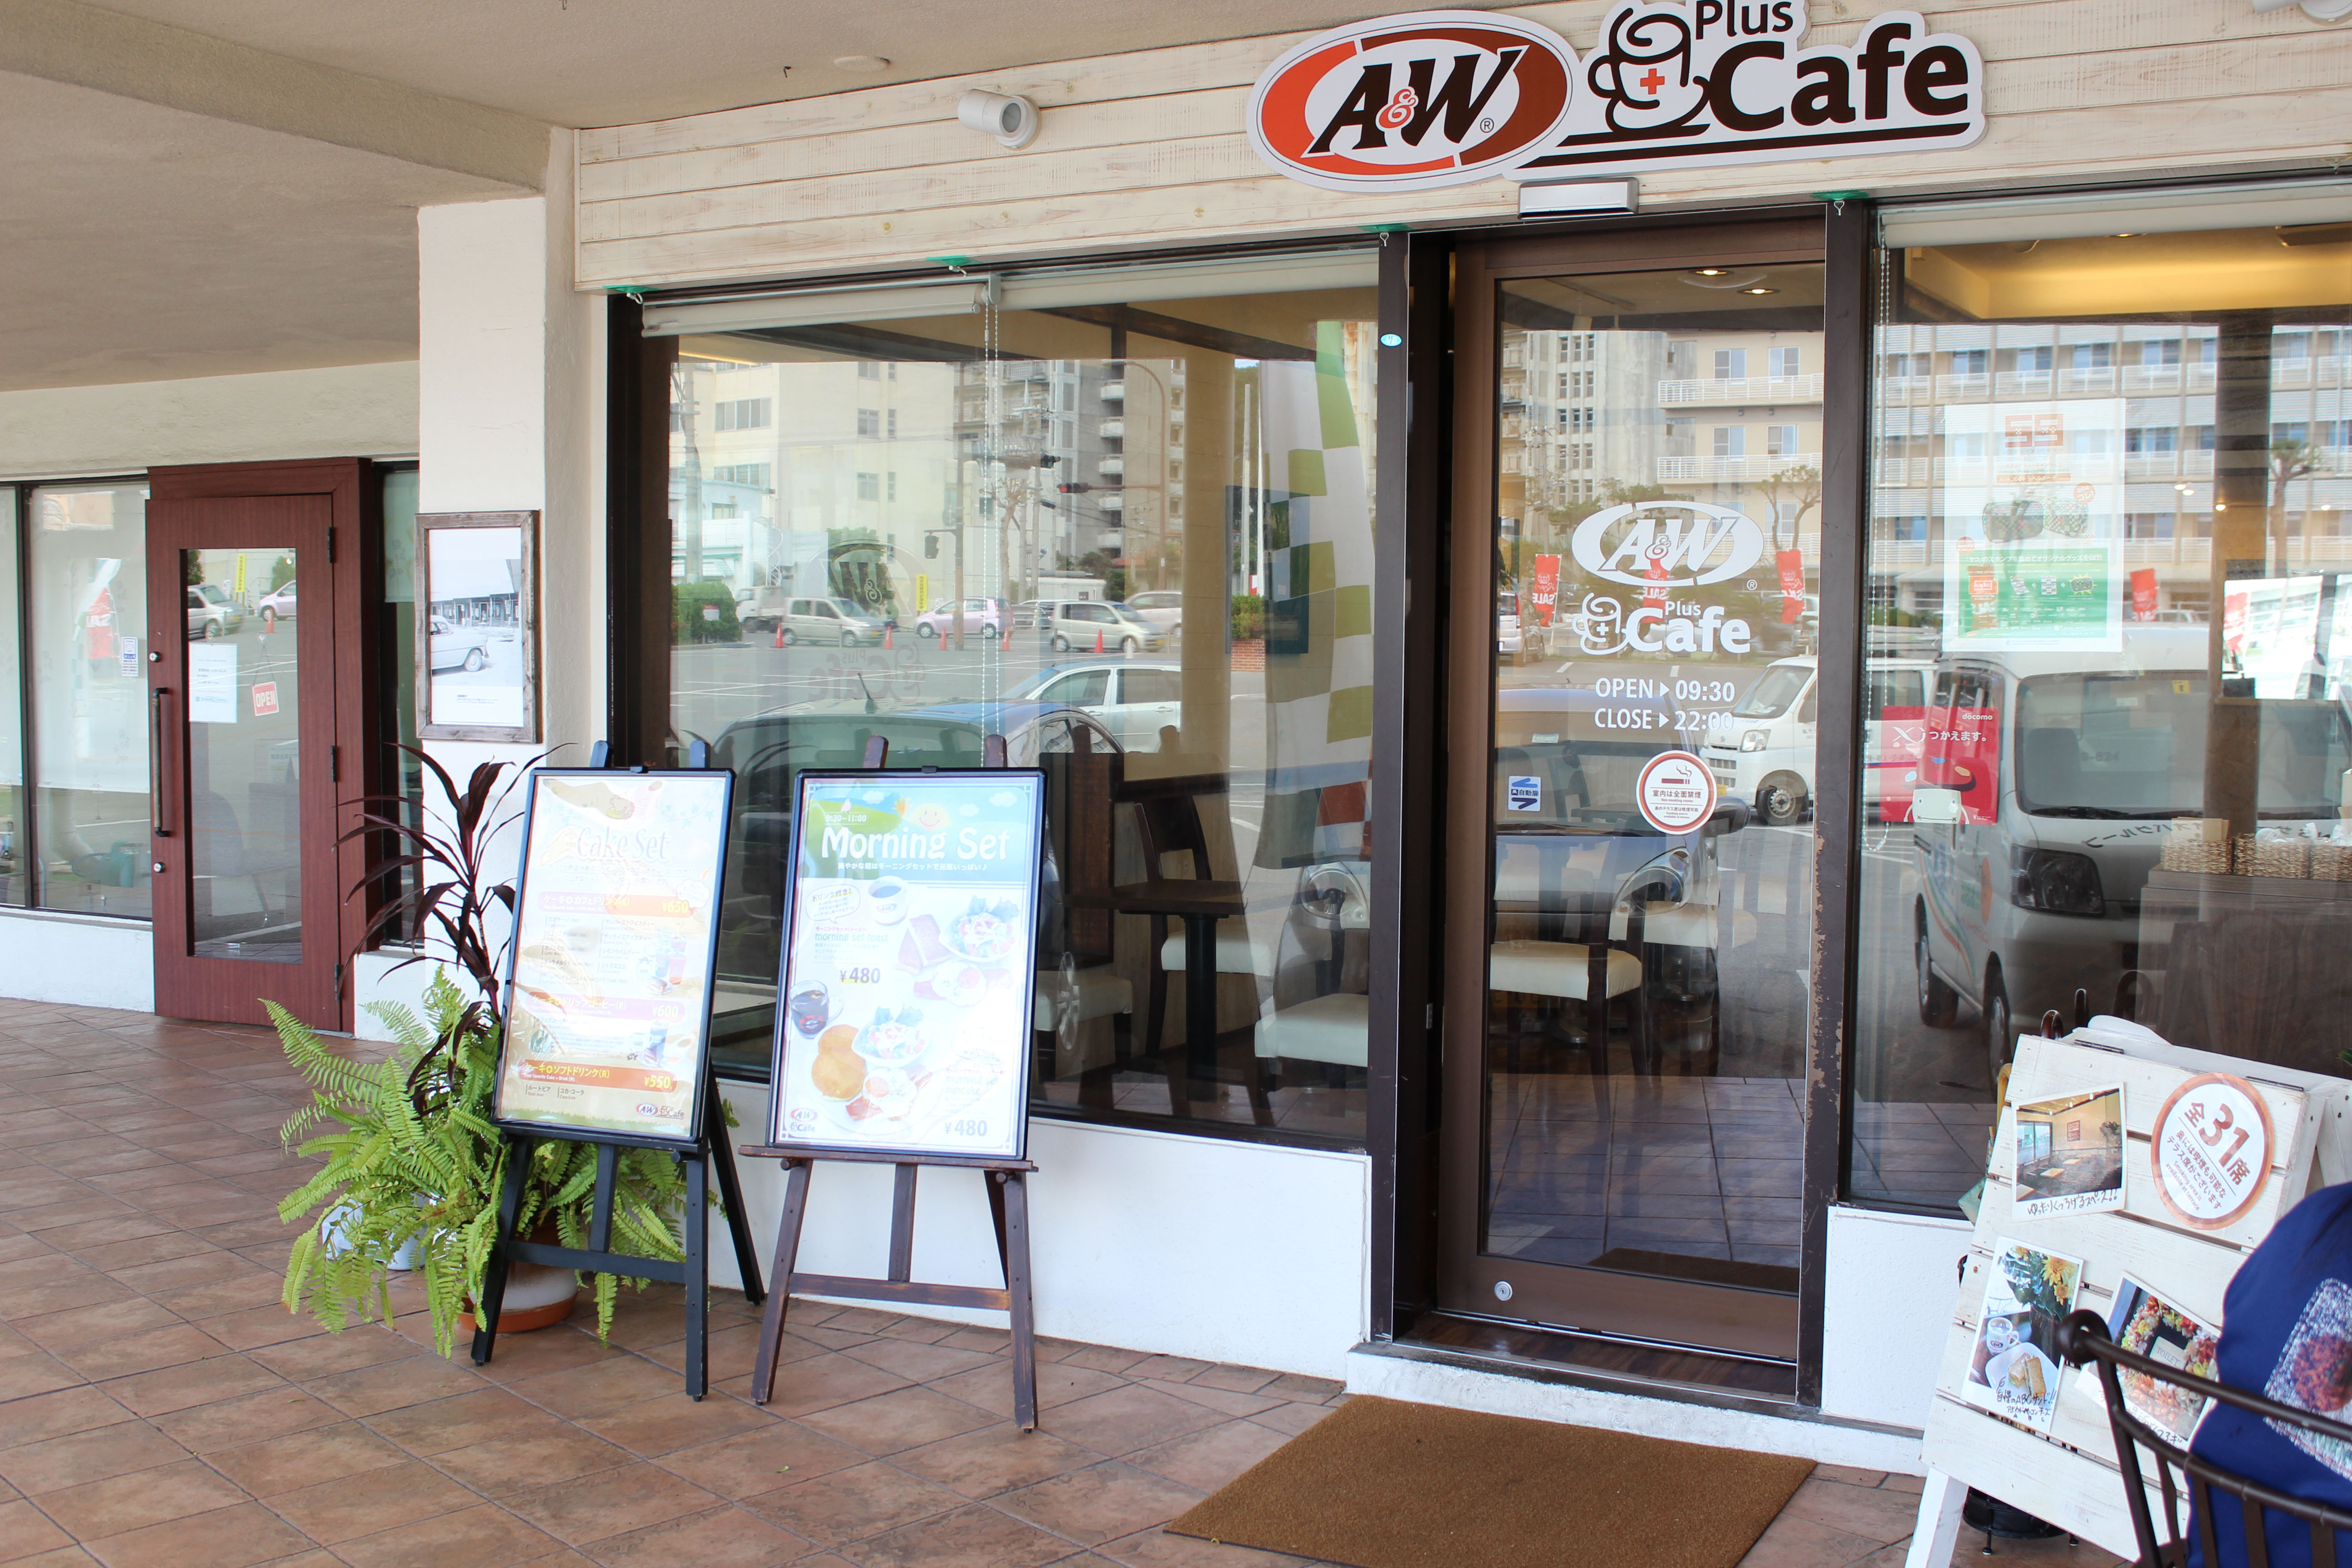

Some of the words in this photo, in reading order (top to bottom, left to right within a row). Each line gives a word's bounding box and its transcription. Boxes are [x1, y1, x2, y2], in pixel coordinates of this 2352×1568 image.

[1695, 0, 1793, 40] Plus
[1300, 46, 1529, 157] A&W
[1709, 22, 1970, 133] Cafe
[1597, 516, 1742, 572] A&W
[1665, 601, 1701, 617] Plus
[1625, 606, 1750, 653] Cafe
[255, 691, 276, 708] OPEN
[1595, 677, 1653, 699] OPEN
[1675, 680, 1735, 702] 09:30
[1594, 708, 1652, 730] CLOSE
[1674, 710, 1734, 732] 22:00
[1929, 731, 1987, 742] つかえます。
[1652, 790, 1701, 799] 室内は全面禁煙
[577, 826, 628, 858] Cake
[632, 828, 671, 861] Set
[821, 826, 947, 860] Morning
[956, 827, 1010, 860] Set
[662, 900, 689, 914] ¥650
[815, 933, 850, 941] morning
[851, 933, 864, 942] set
[839, 967, 881, 984] ¥480
[652, 1005, 679, 1018] ¥600
[644, 1076, 671, 1088] ¥550
[667, 1108, 684, 1118] Cafe
[944, 1119, 988, 1137] ¥480
[2167, 1135, 2222, 1209] テラス席がございます
[2176, 1130, 2226, 1199] 奥には喫煙も可能な
[2166, 1163, 2183, 1187] available
[2185, 1190, 2200, 1211] terrace
[2173, 1160, 2190, 1185] Smoking
[2189, 1181, 2199, 1196] area
[2156, 1346, 2180, 1366] TOILET
